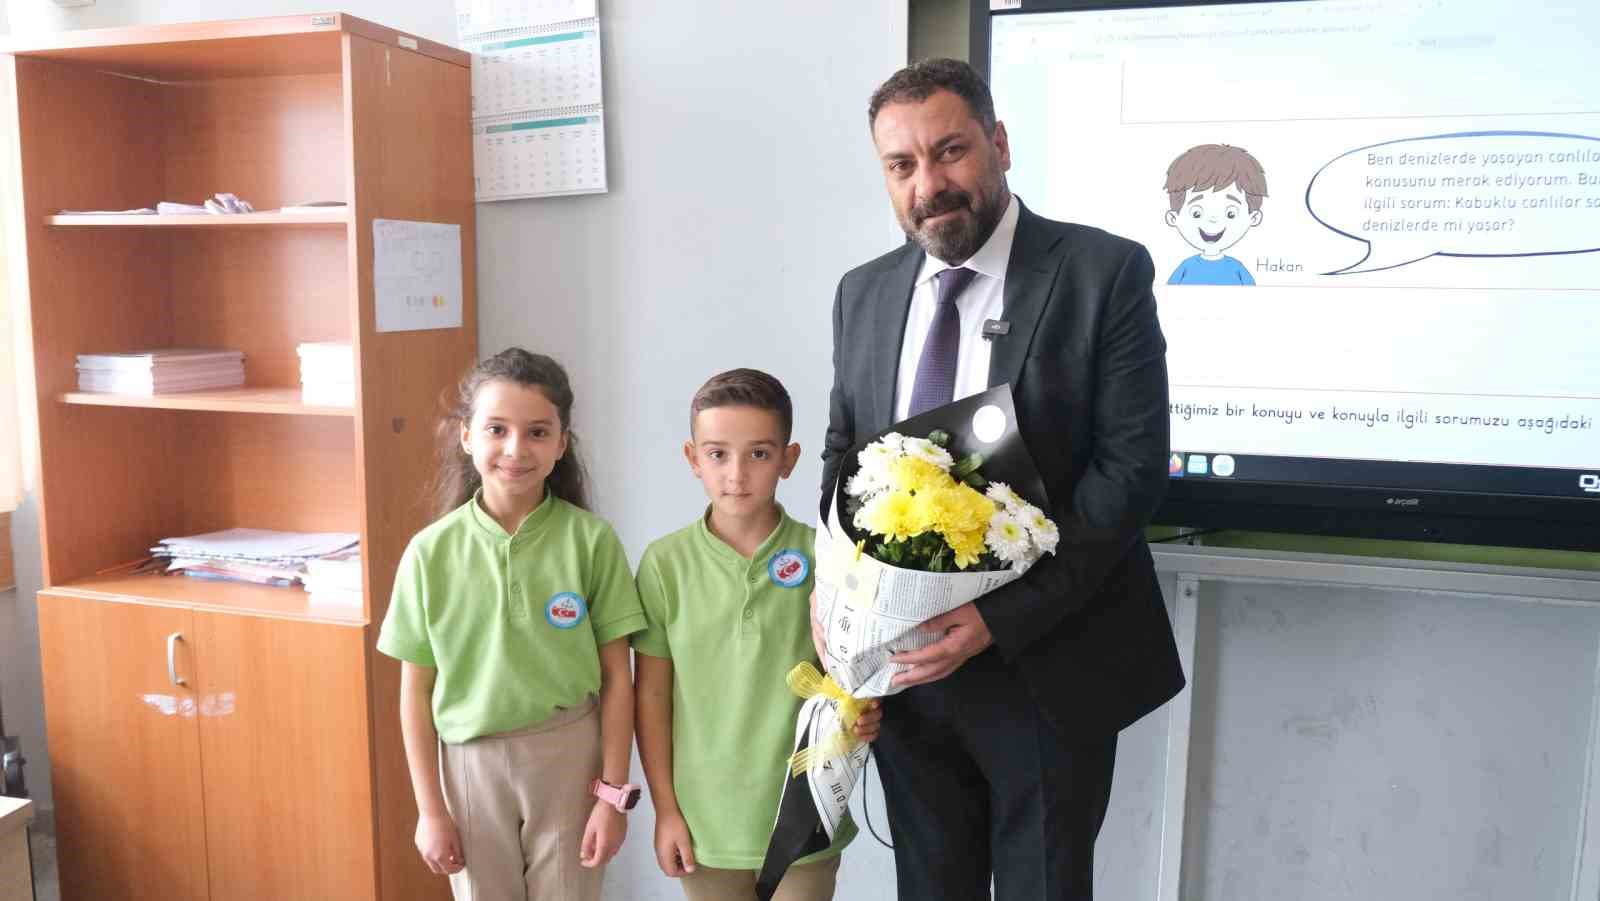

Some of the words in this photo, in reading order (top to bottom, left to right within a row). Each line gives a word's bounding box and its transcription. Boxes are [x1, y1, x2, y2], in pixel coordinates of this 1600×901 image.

[1367, 153, 1393, 166] Ben
[1399, 153, 1476, 166] denizlerde
[1366, 175, 1436, 188] konusunu
[1441, 175, 1490, 187] merak
[1495, 173, 1573, 189] ediyorum.
[1364, 195, 1396, 212] ilgili
[1455, 196, 1517, 209] Kabuklu
[1362, 218, 1439, 232] denizlerde
[1443, 217, 1463, 231] mi
[1256, 257, 1304, 272] Hakan
[1226, 402, 1245, 416] bir
[1252, 403, 1302, 424] konuyu
[1310, 411, 1325, 419] ve
[1332, 406, 1389, 427] konuyla
[1397, 408, 1428, 429] ilgili
[1435, 415, 1510, 426] sorumuzu
[1518, 414, 1593, 434] aşağıdaki
